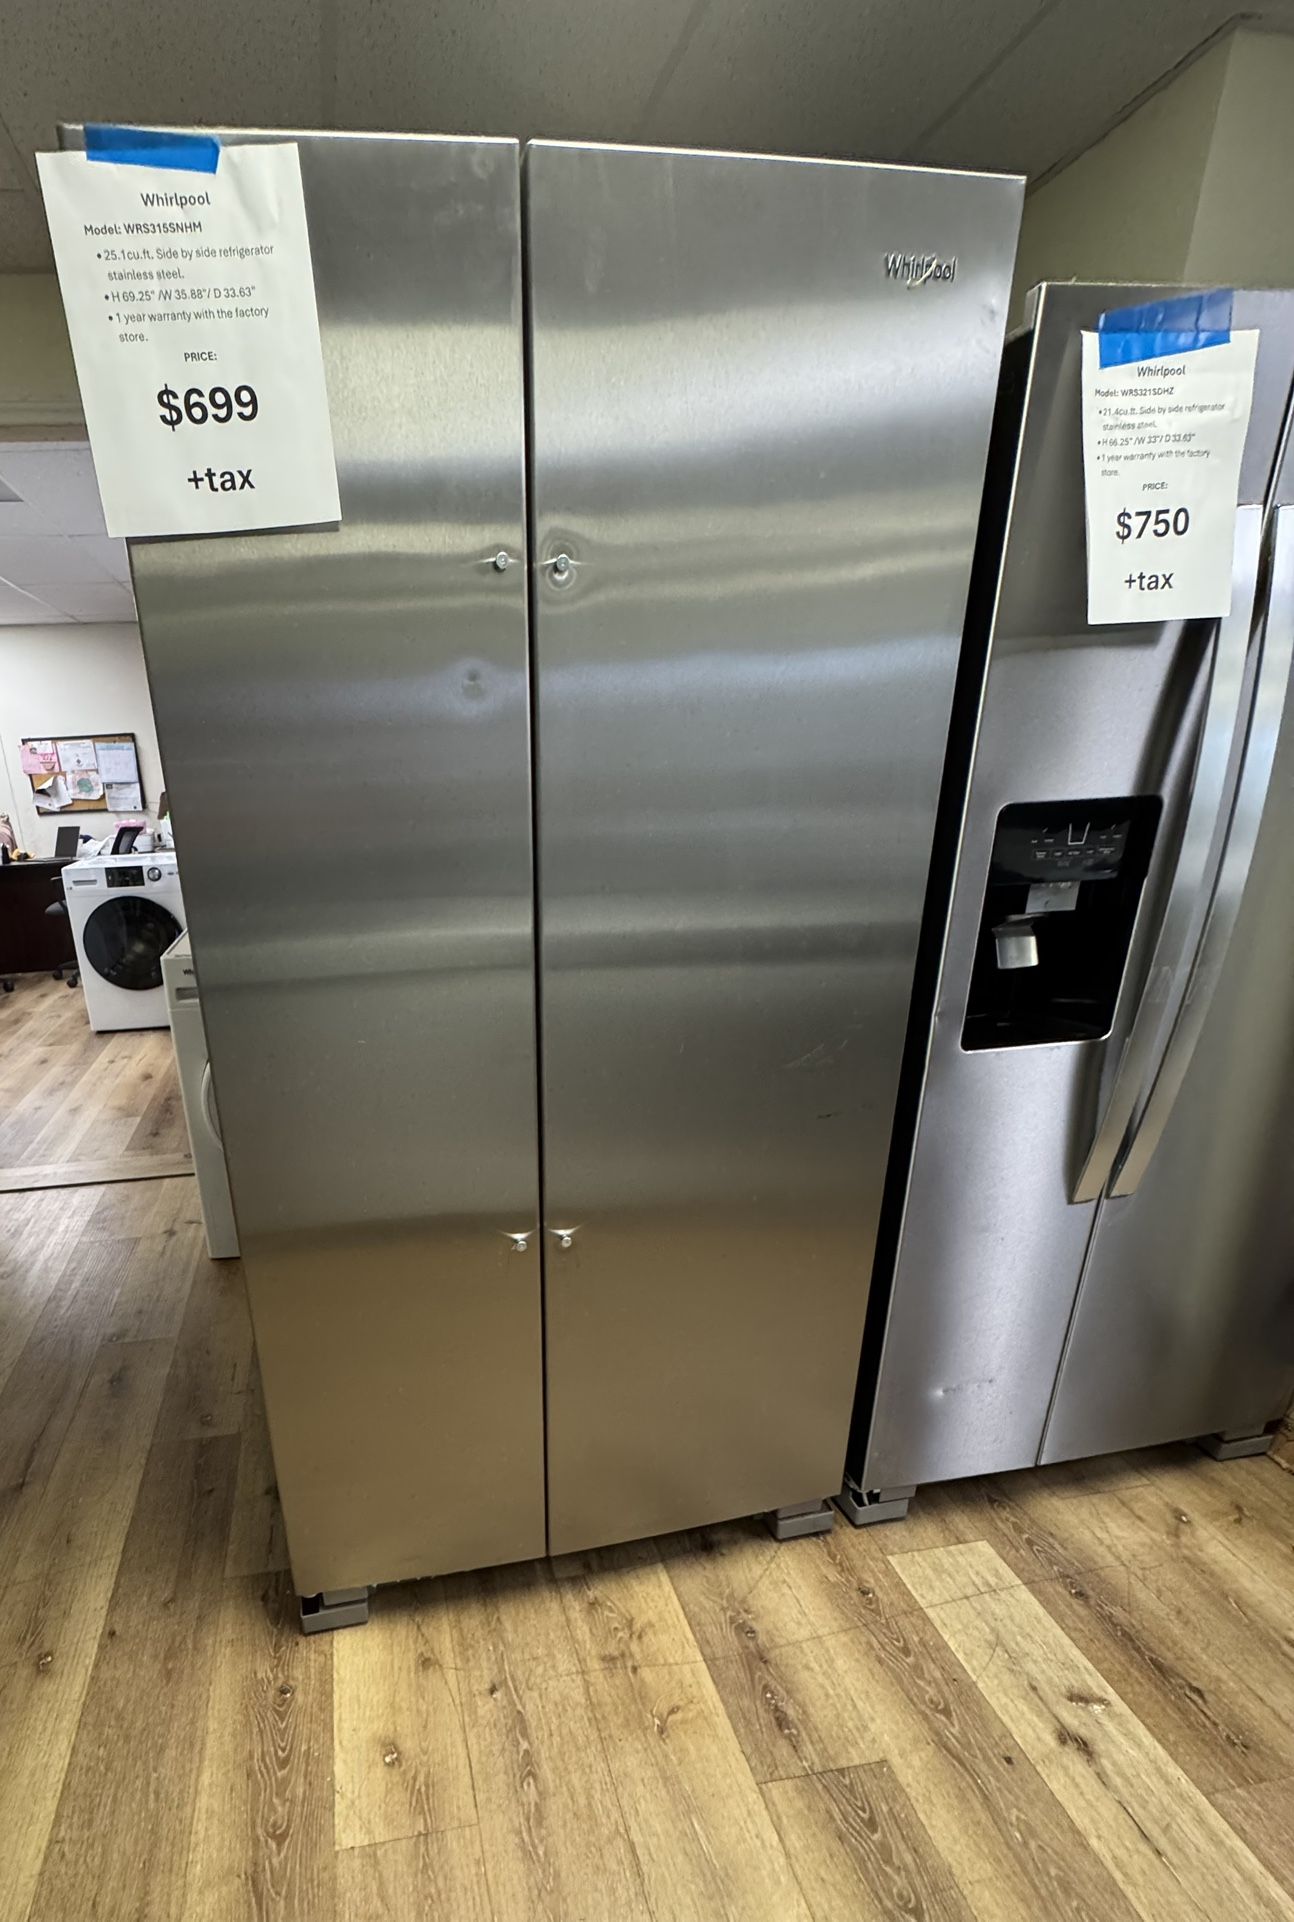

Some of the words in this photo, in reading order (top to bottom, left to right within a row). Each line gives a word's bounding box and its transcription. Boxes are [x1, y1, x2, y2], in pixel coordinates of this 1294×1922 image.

[140, 191, 211, 209] Whirlpool
[84, 224, 122, 236] Model:
[123, 221, 203, 234] WRS315SNHM
[103, 248, 154, 261] 25.1cu.ft.
[156, 247, 179, 260] Side
[180, 247, 193, 261] by
[195, 246, 217, 258] side
[219, 245, 274, 259] refrigerator
[107, 268, 154, 281] stainless
[156, 266, 185, 280] steel.
[884, 253, 957, 285] Whirlpool
[111, 291, 121, 302] H
[122, 289, 155, 302] 69.25"
[158, 289, 172, 301] /W
[213, 287, 222, 299] D
[223, 285, 256, 298] 33.63"
[123, 313, 146, 325] year
[147, 310, 192, 323] warranty
[193, 308, 216, 320] with
[216, 308, 233, 319] the
[235, 306, 269, 319] factory
[119, 332, 149, 343] store.
[183, 351, 218, 363] PRICE:
[1137, 365, 1185, 378] Whirlpool
[1095, 389, 1119, 397] Model:
[157, 383, 259, 432] $699
[1139, 405, 1156, 415] Side
[1157, 405, 1166, 415] by
[1167, 403, 1183, 414] side
[1184, 402, 1225, 414] refrigerator
[1103, 422, 1136, 431] stainless
[1102, 438, 1108, 446] H
[1164, 433, 1171, 443] D
[1107, 454, 1122, 463] year
[1123, 451, 1156, 461] warranty
[1157, 449, 1174, 459] with
[1174, 449, 1186, 459] the
[187, 467, 256, 492] +tax
[1142, 481, 1169, 491] PRICE:
[1115, 507, 1190, 544] $750
[1124, 571, 1175, 591] +tax
